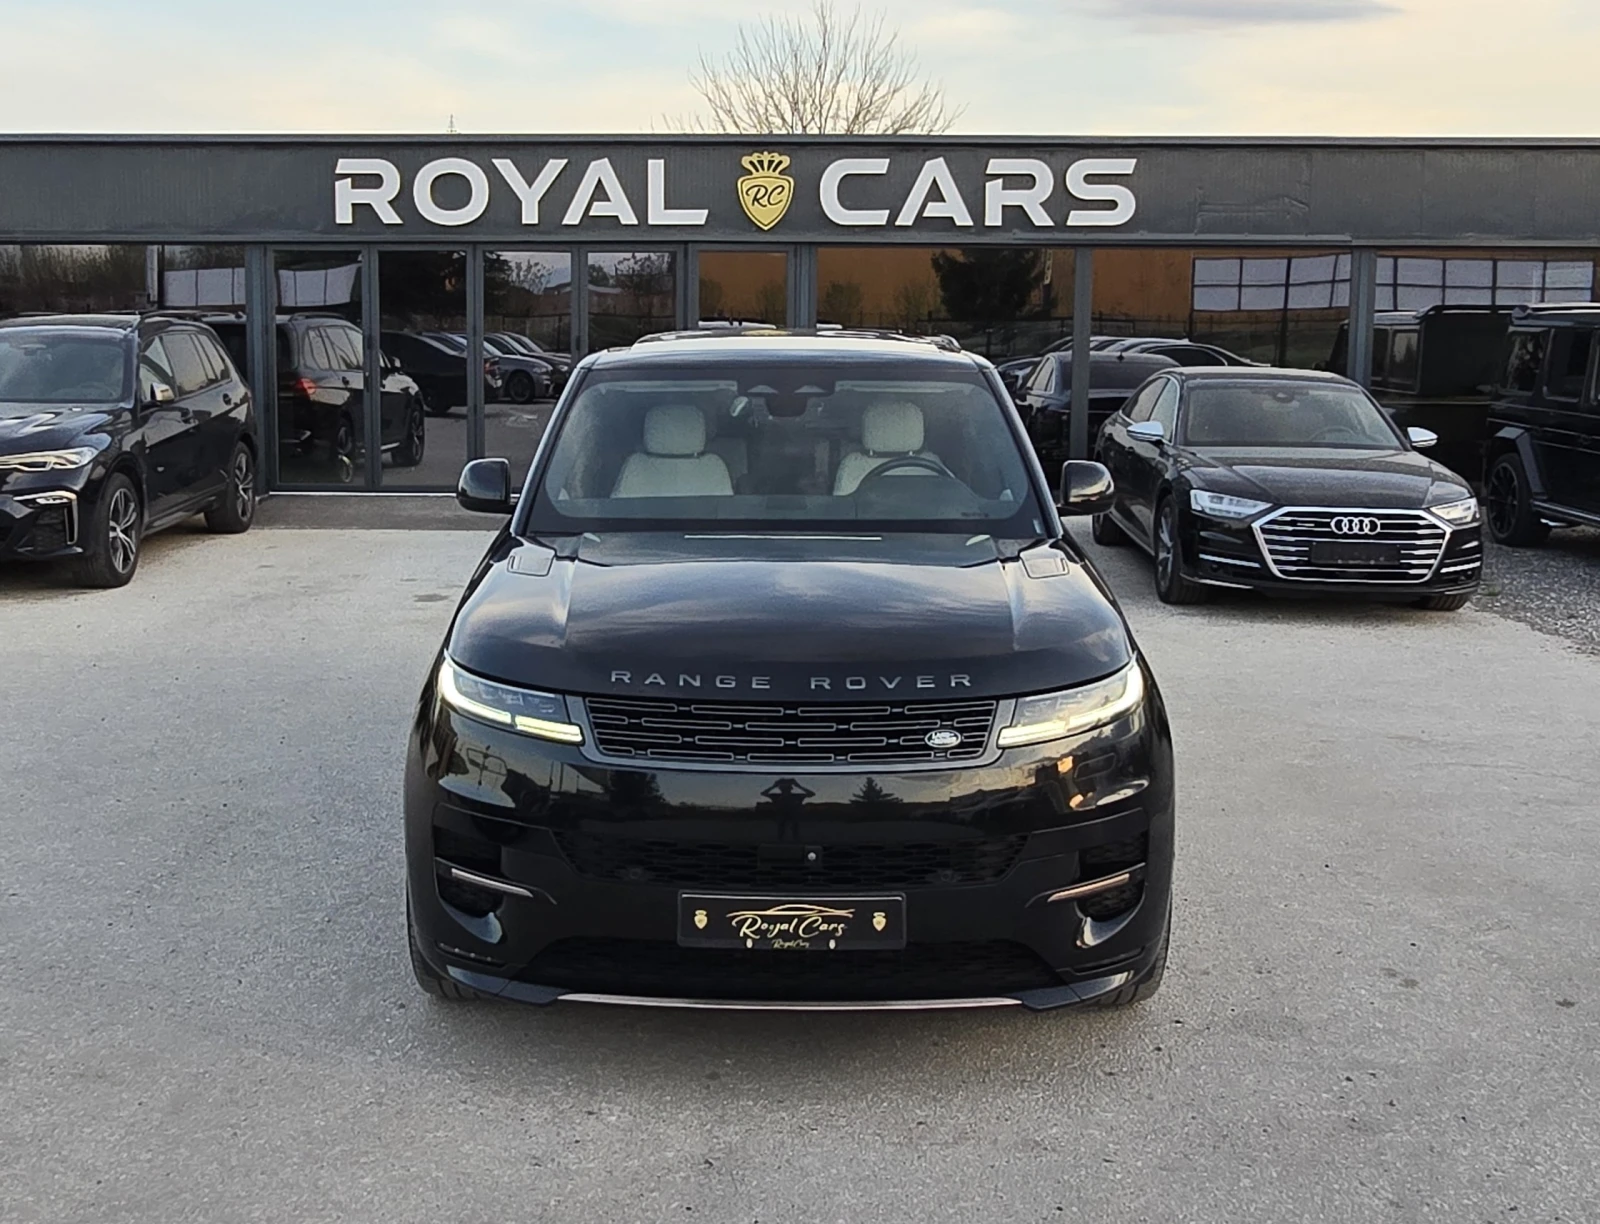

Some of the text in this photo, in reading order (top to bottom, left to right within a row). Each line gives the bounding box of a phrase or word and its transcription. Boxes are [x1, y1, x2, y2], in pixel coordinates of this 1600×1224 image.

[335, 157, 709, 226] ROYAL
[745, 184, 785, 208] RC
[819, 157, 1137, 226] CARS
[610, 670, 972, 690] RANGE ROVER
[731, 915, 846, 938] Royal Cars
